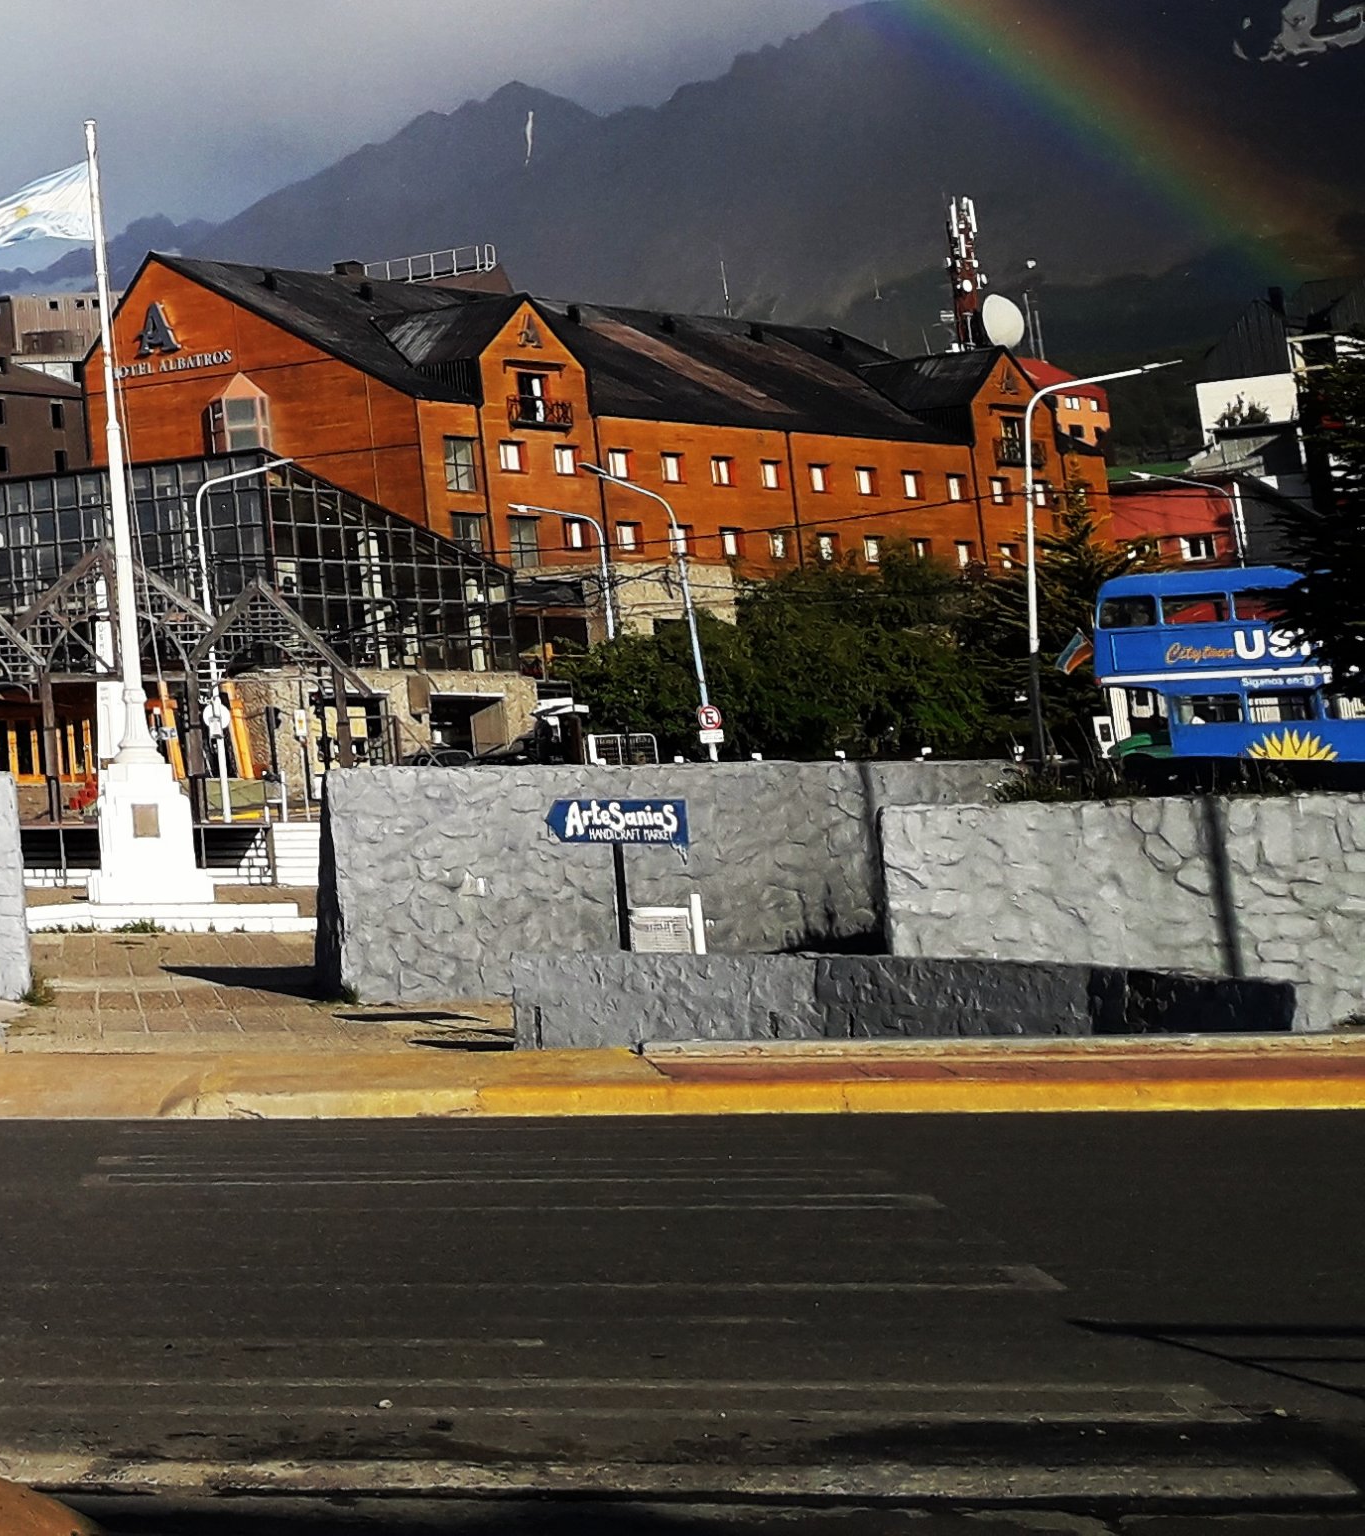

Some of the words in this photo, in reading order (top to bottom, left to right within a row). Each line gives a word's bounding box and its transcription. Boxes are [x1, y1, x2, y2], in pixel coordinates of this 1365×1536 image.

[159, 349, 232, 373] ALBATROS
[589, 828, 641, 840] HANDICRAFT
[643, 828, 673, 841] MARKET
